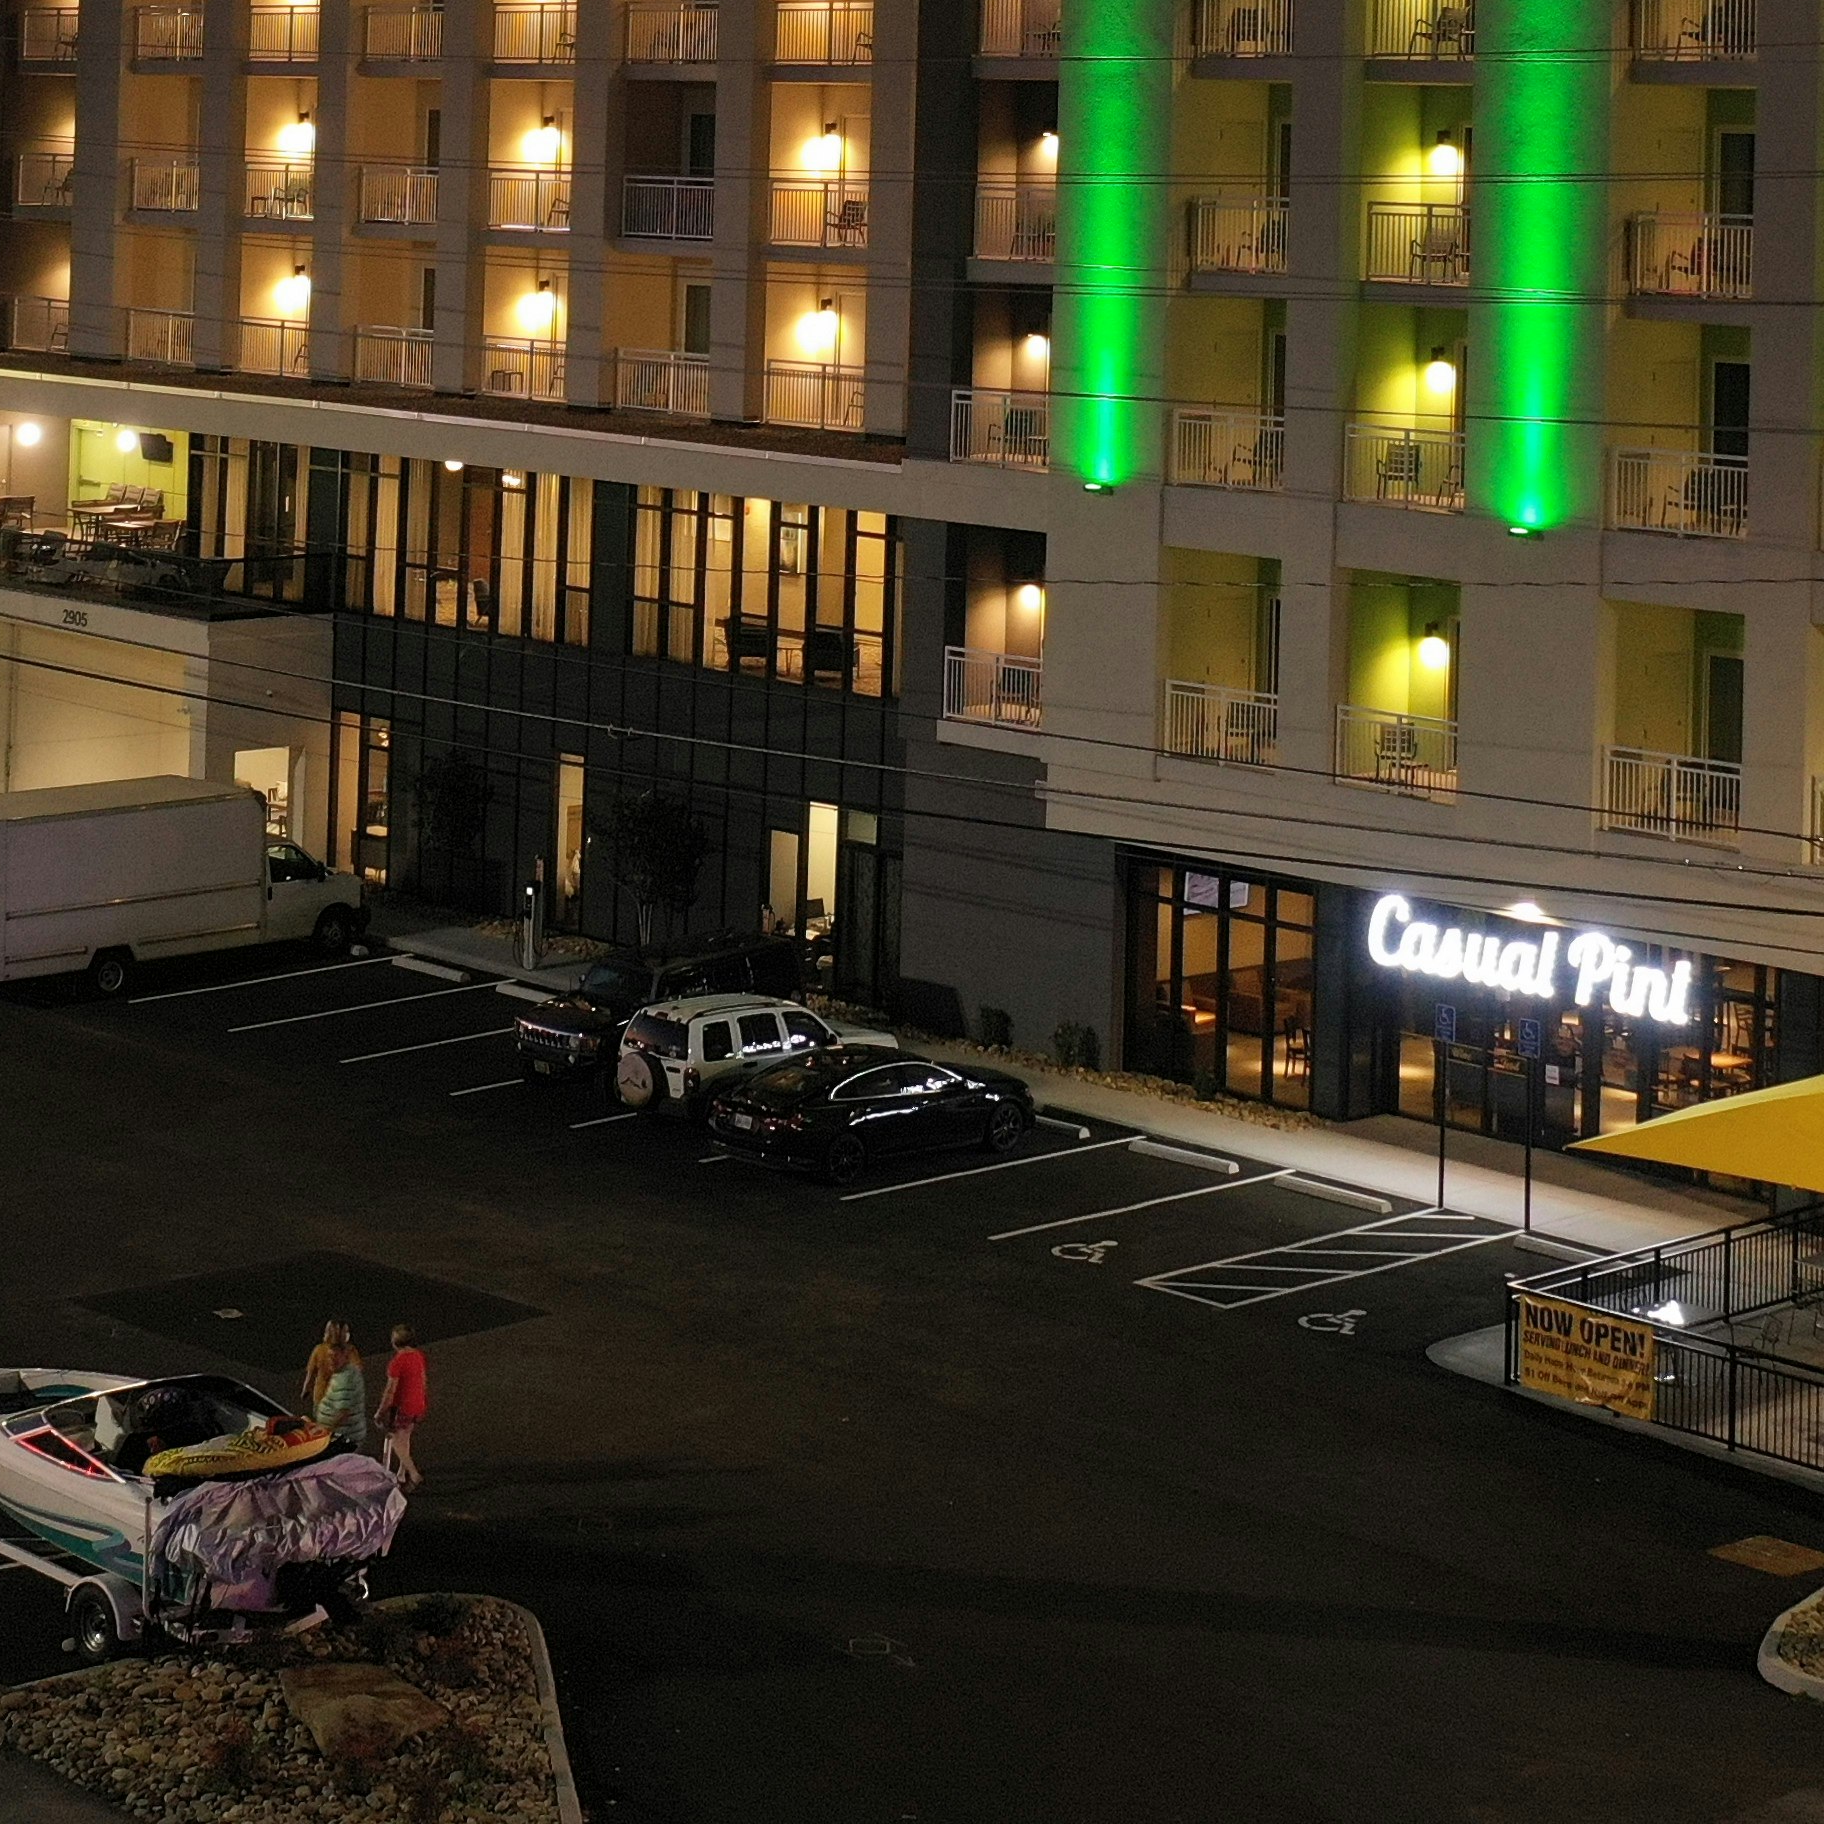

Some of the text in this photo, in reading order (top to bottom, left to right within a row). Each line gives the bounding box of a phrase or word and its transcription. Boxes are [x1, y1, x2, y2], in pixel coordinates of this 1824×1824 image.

[62, 608, 88, 627] 2905
[1367, 894, 1692, 1026] Casual Pint
[1524, 1304, 1646, 1359] NOW OPEN!
